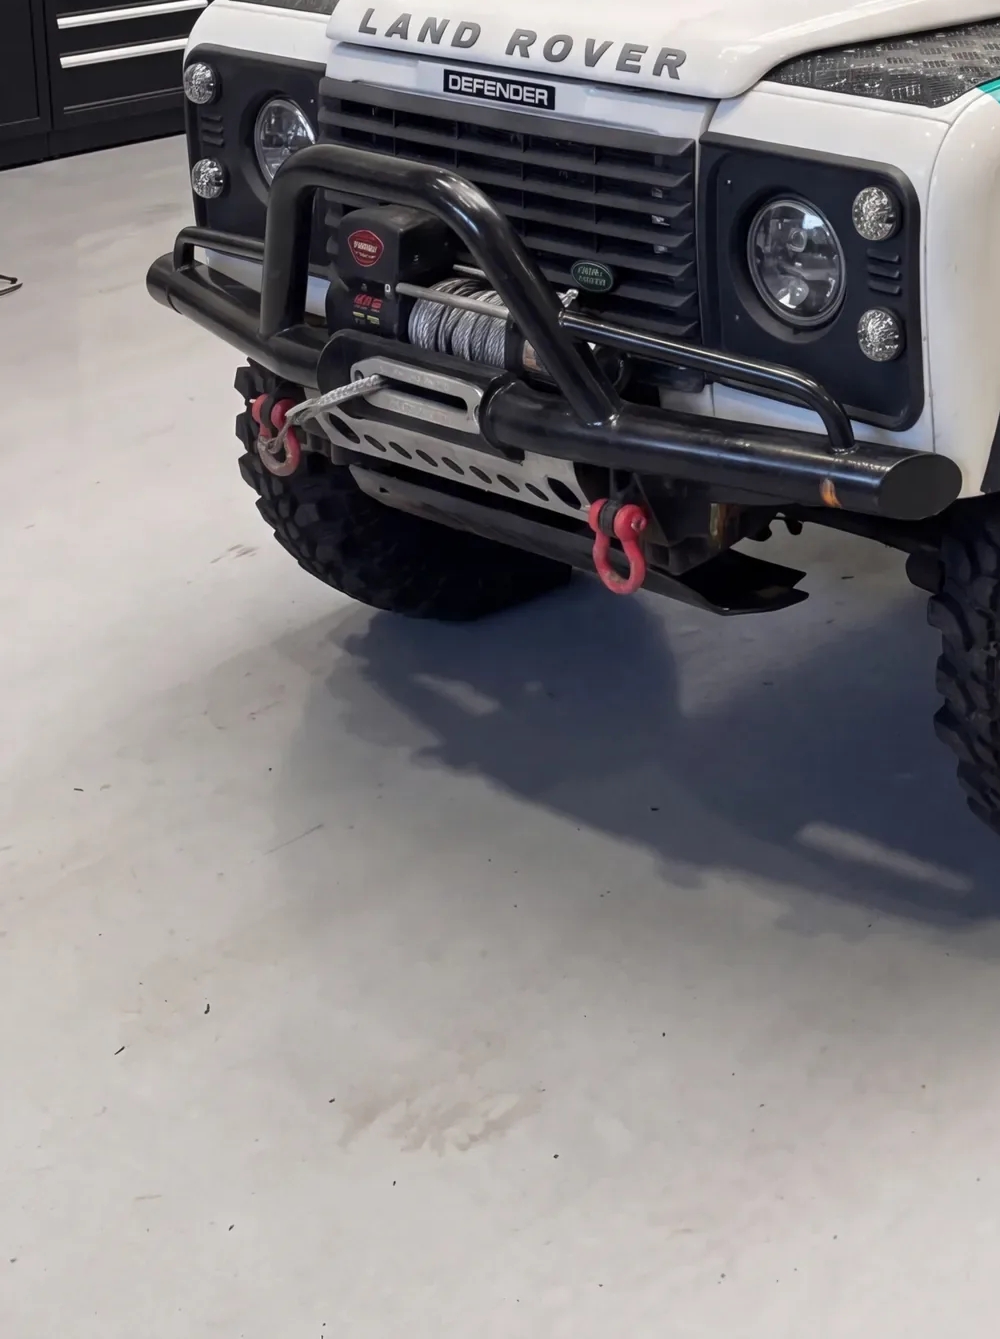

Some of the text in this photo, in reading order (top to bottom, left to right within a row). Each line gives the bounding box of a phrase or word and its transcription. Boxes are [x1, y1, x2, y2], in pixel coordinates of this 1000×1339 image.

[358, 8, 687, 80] LAND ROVER
[448, 74, 548, 106] DEFENDER
